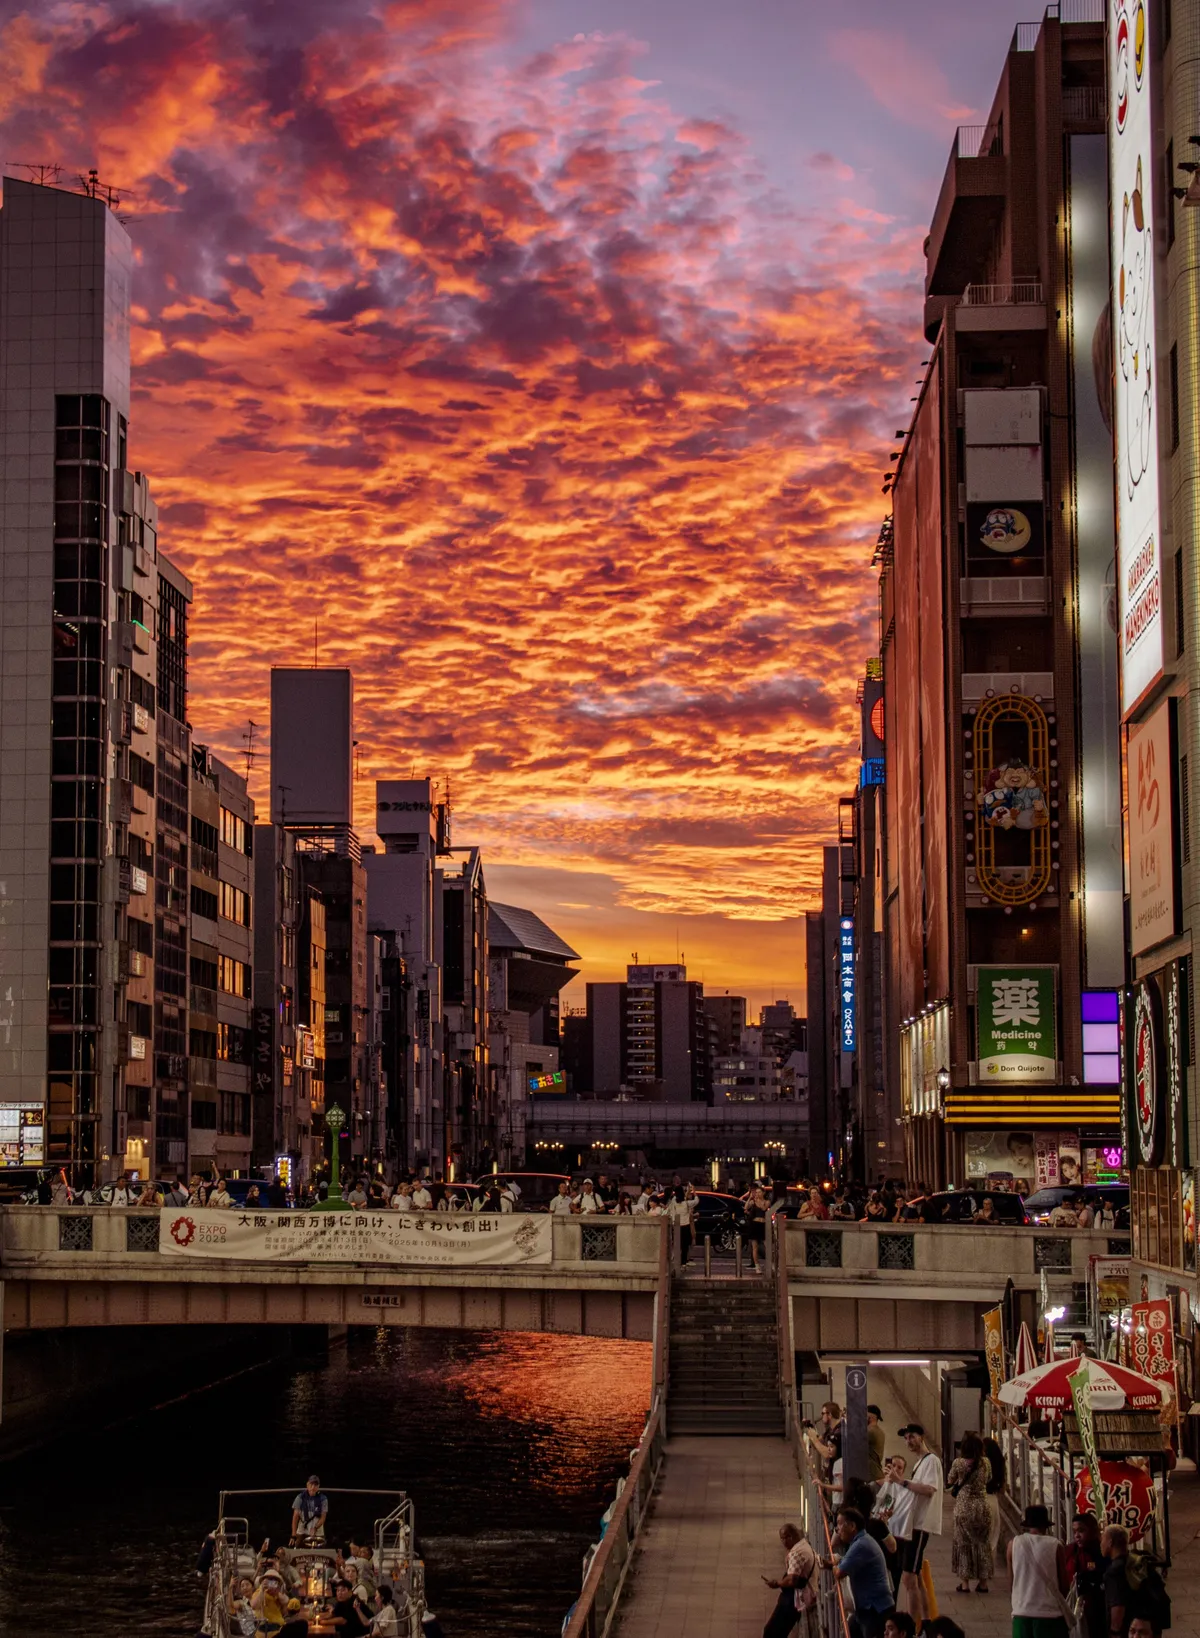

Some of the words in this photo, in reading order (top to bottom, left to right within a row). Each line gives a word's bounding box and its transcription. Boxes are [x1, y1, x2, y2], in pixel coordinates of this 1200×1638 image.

[1125, 570, 1159, 656] MANEKINEKO
[991, 978, 1041, 1026] 薬
[843, 1008, 853, 1046] OKAMOTO
[991, 1030, 1042, 1039] Medicine
[996, 1041, 1006, 1051] 药
[1027, 1041, 1037, 1051] 약
[1017, 1065, 1045, 1073] Quijote
[199, 1225, 227, 1235] EXPO
[199, 1235, 227, 1243] 2025
[1009, 1379, 1032, 1389] KIRIN
[1089, 1384, 1117, 1392] IRIN
[1035, 1396, 1065, 1407] KIRIN
[1132, 1394, 1157, 1407] KIRIN
